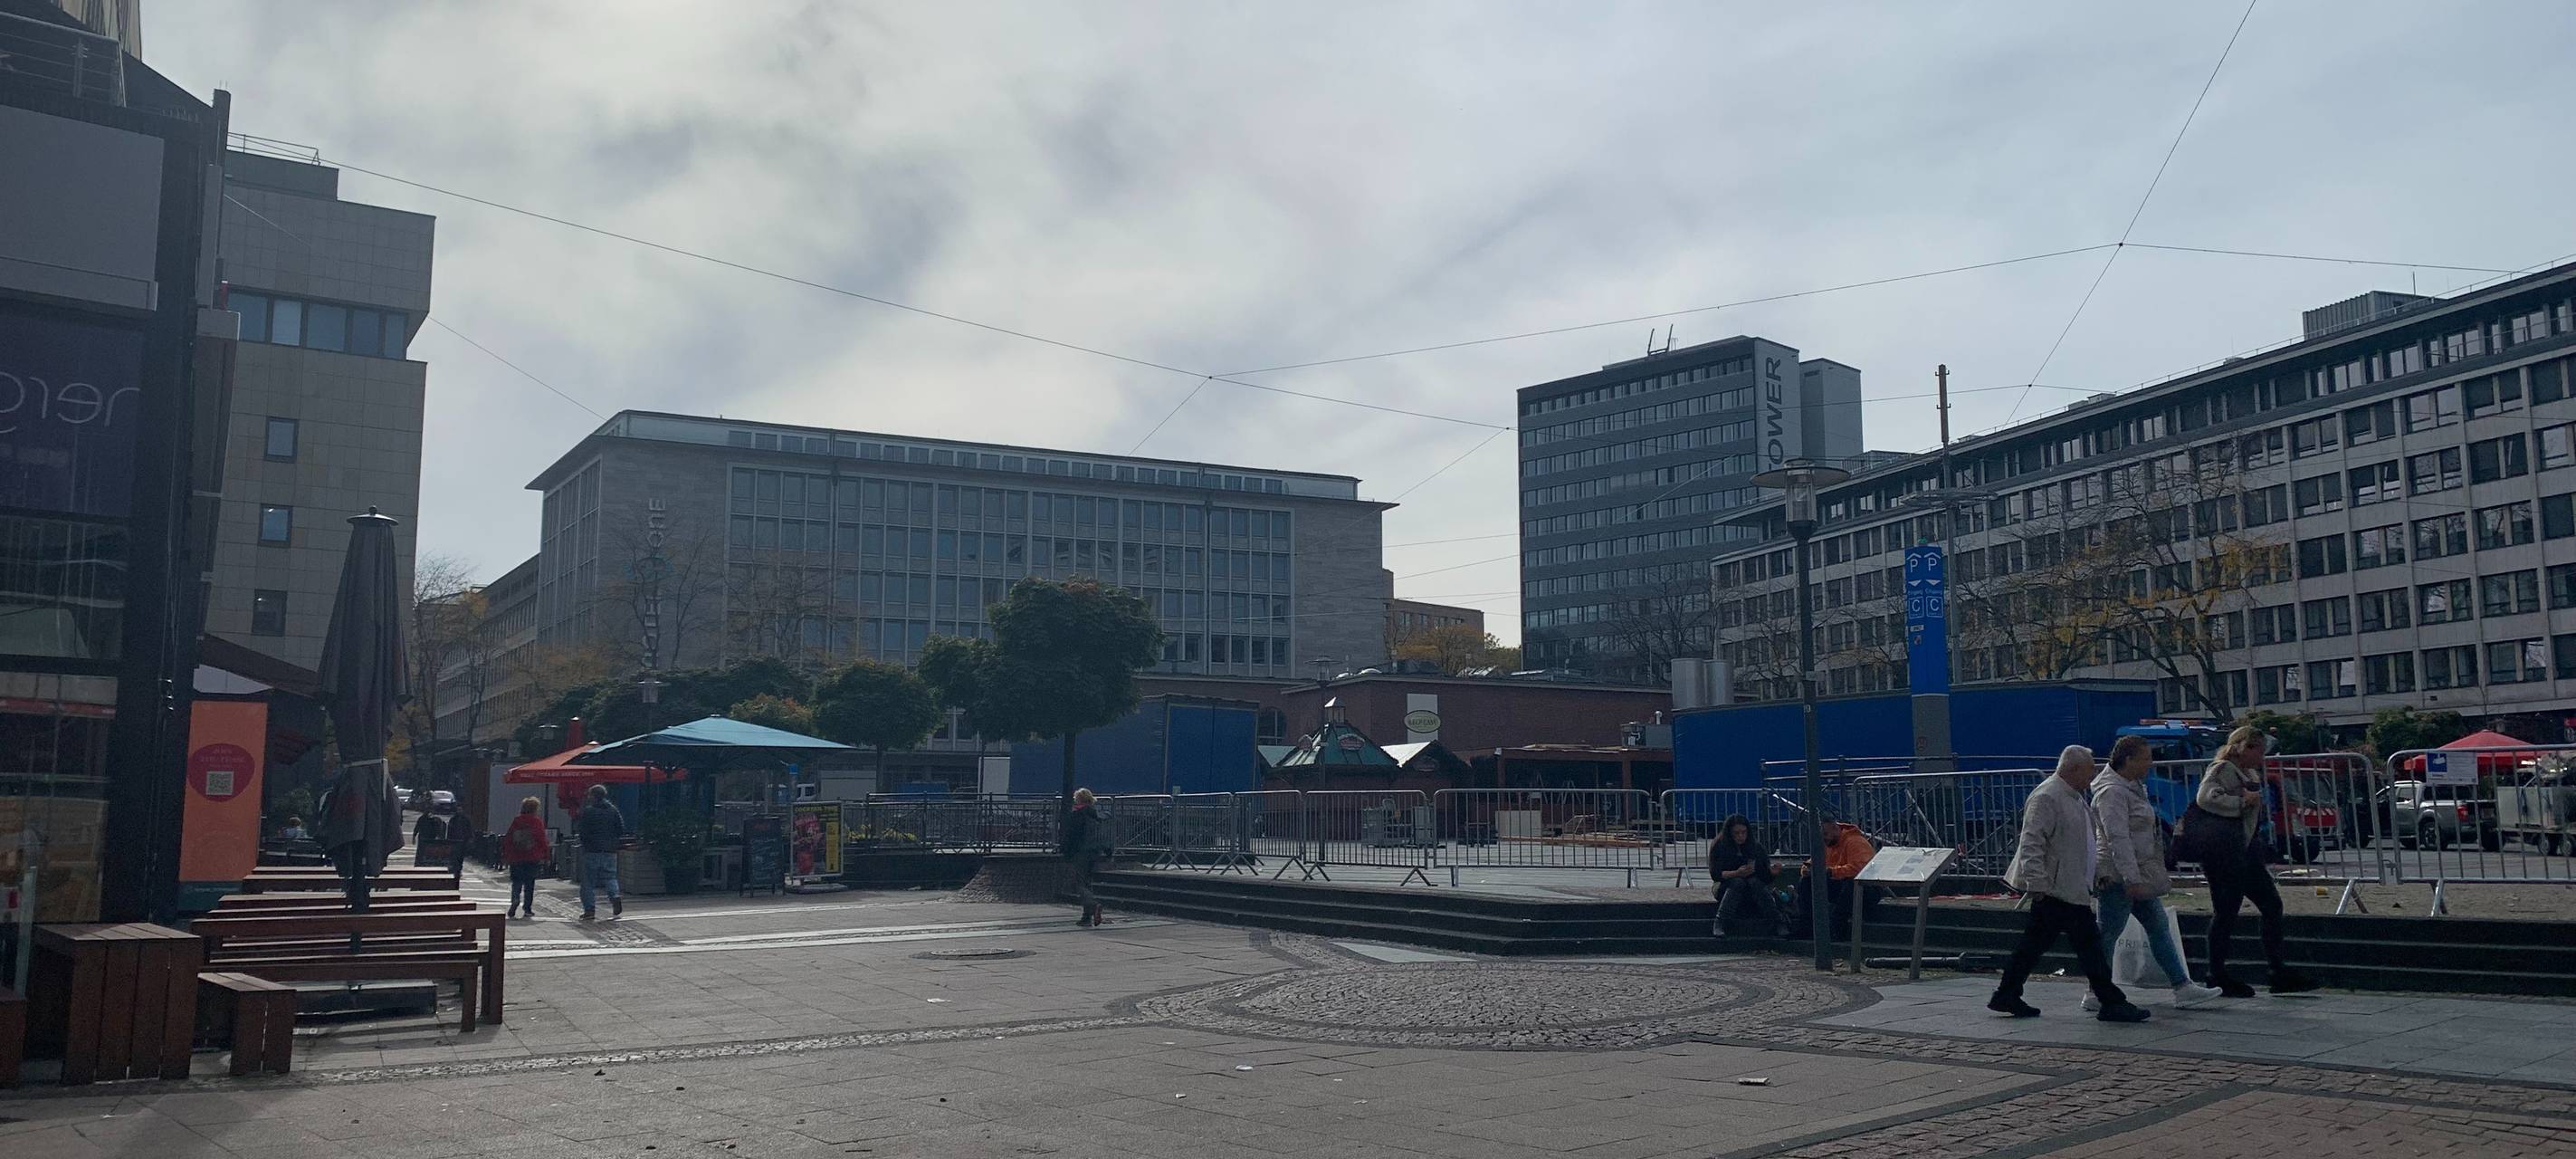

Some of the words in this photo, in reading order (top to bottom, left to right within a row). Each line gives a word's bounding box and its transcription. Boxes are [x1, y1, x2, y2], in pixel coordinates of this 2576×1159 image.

[1765, 357, 1786, 471] OWER
[1910, 559, 1918, 572] P
[1928, 558, 1937, 570] P
[1912, 599, 1920, 611] C
[1930, 599, 1939, 610] C
